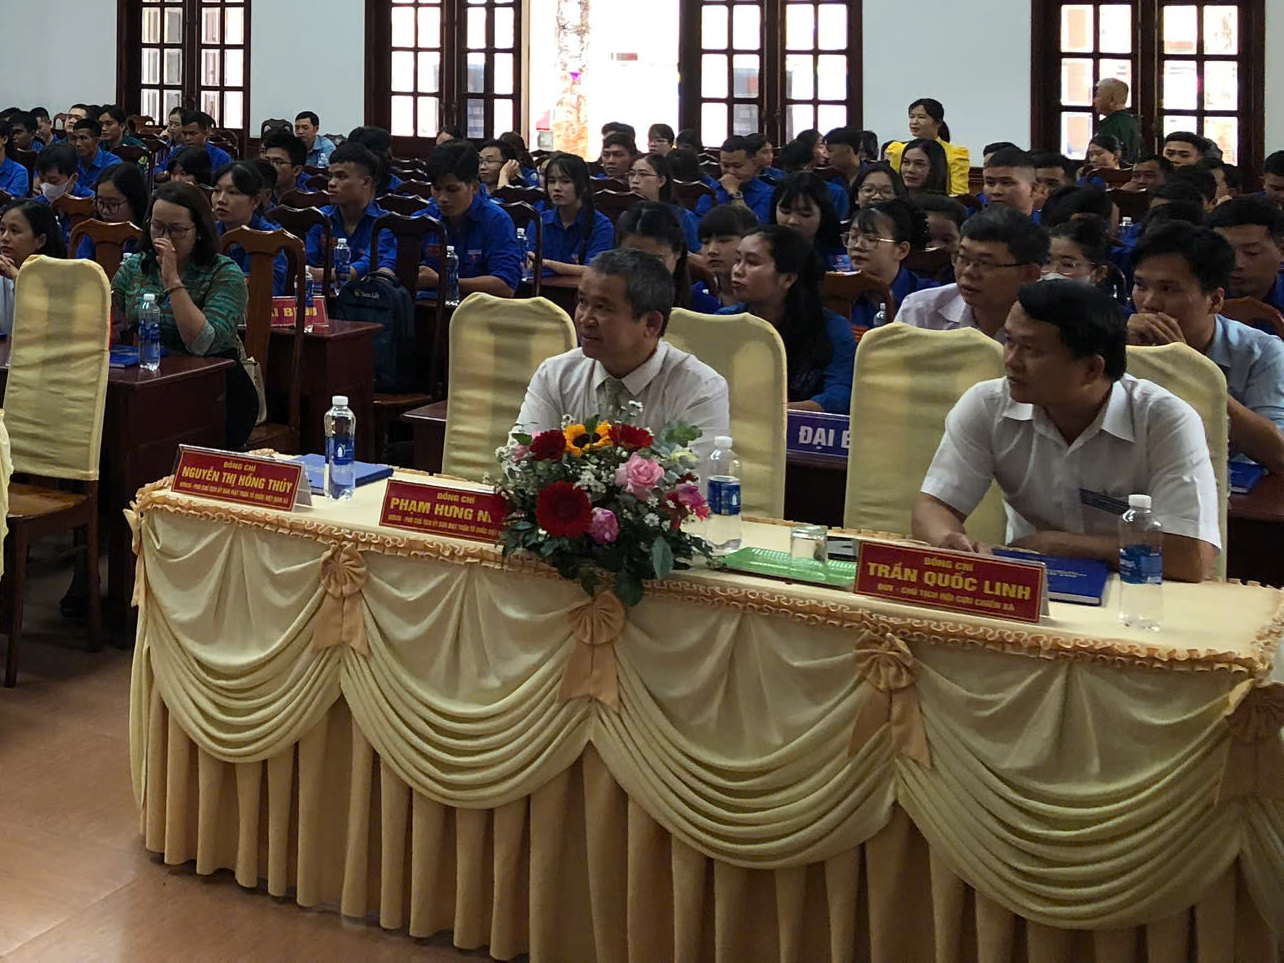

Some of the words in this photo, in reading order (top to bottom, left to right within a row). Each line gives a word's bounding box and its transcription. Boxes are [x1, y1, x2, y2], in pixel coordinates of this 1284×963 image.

[799, 425, 835, 450] ĐẠI
[221, 472, 237, 487] THỊ
[390, 497, 431, 515] PHẠM
[434, 504, 474, 520] HƯNG
[867, 561, 918, 583] TRẦN
[924, 570, 979, 592] QUỐC
[984, 580, 1032, 601] LINH
